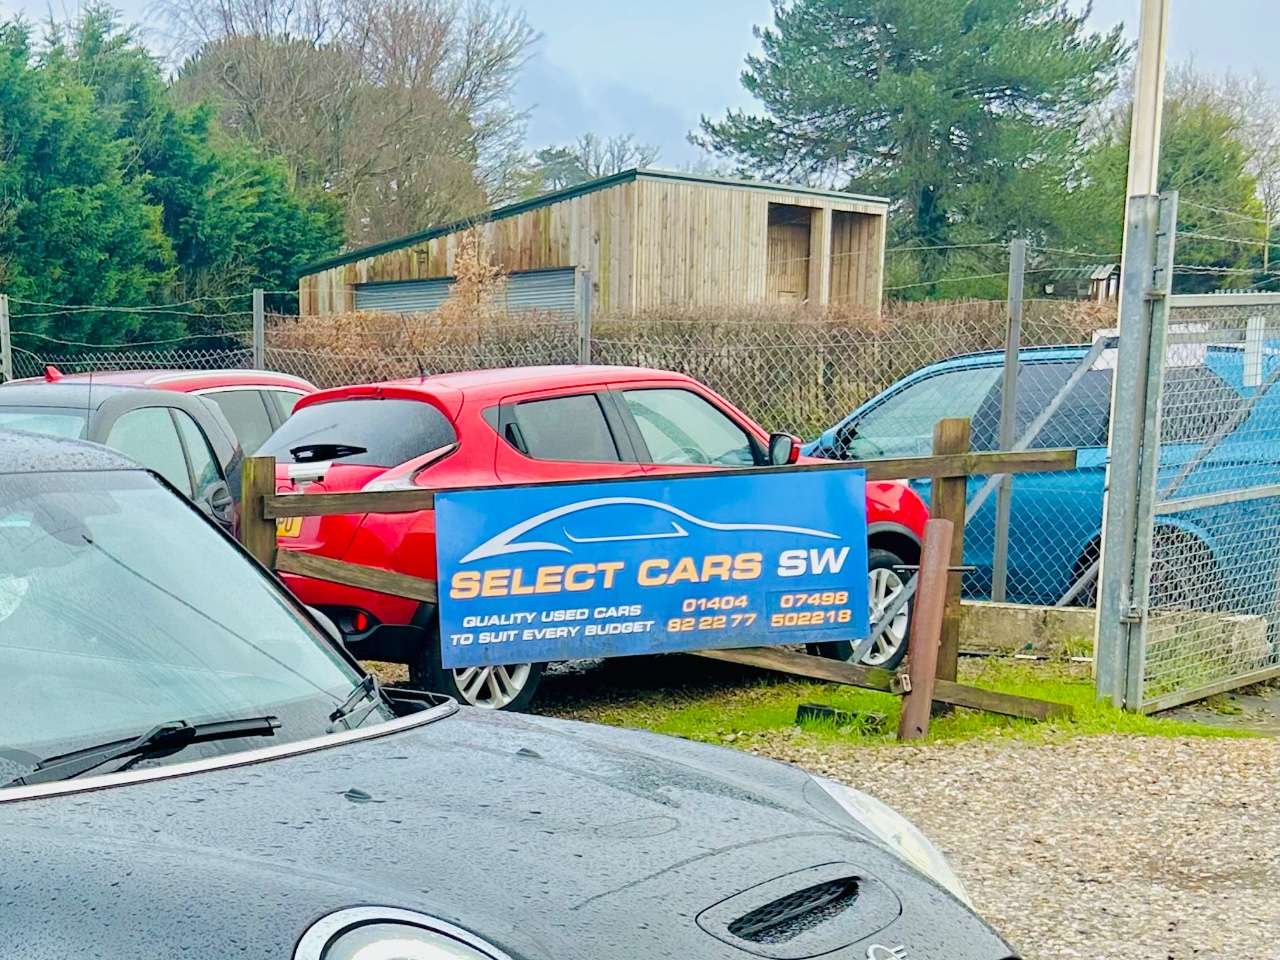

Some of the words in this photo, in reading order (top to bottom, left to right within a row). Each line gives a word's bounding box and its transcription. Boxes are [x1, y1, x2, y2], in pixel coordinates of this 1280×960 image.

[449, 562, 628, 600] SELECT
[636, 551, 763, 588] CARS
[776, 546, 850, 577] SW
[682, 594, 749, 613] 01404
[463, 612, 536, 628] QUALITY
[541, 608, 589, 622] USED
[593, 604, 642, 619] CARS
[667, 617, 695, 632] 82
[698, 615, 726, 630] 22
[731, 613, 758, 627] 77
[770, 609, 853, 627] 502218
[450, 633, 473, 646] TO
[478, 630, 518, 644] SUIT
[522, 625, 580, 641] EVERY
[584, 620, 655, 636] BUDGET
